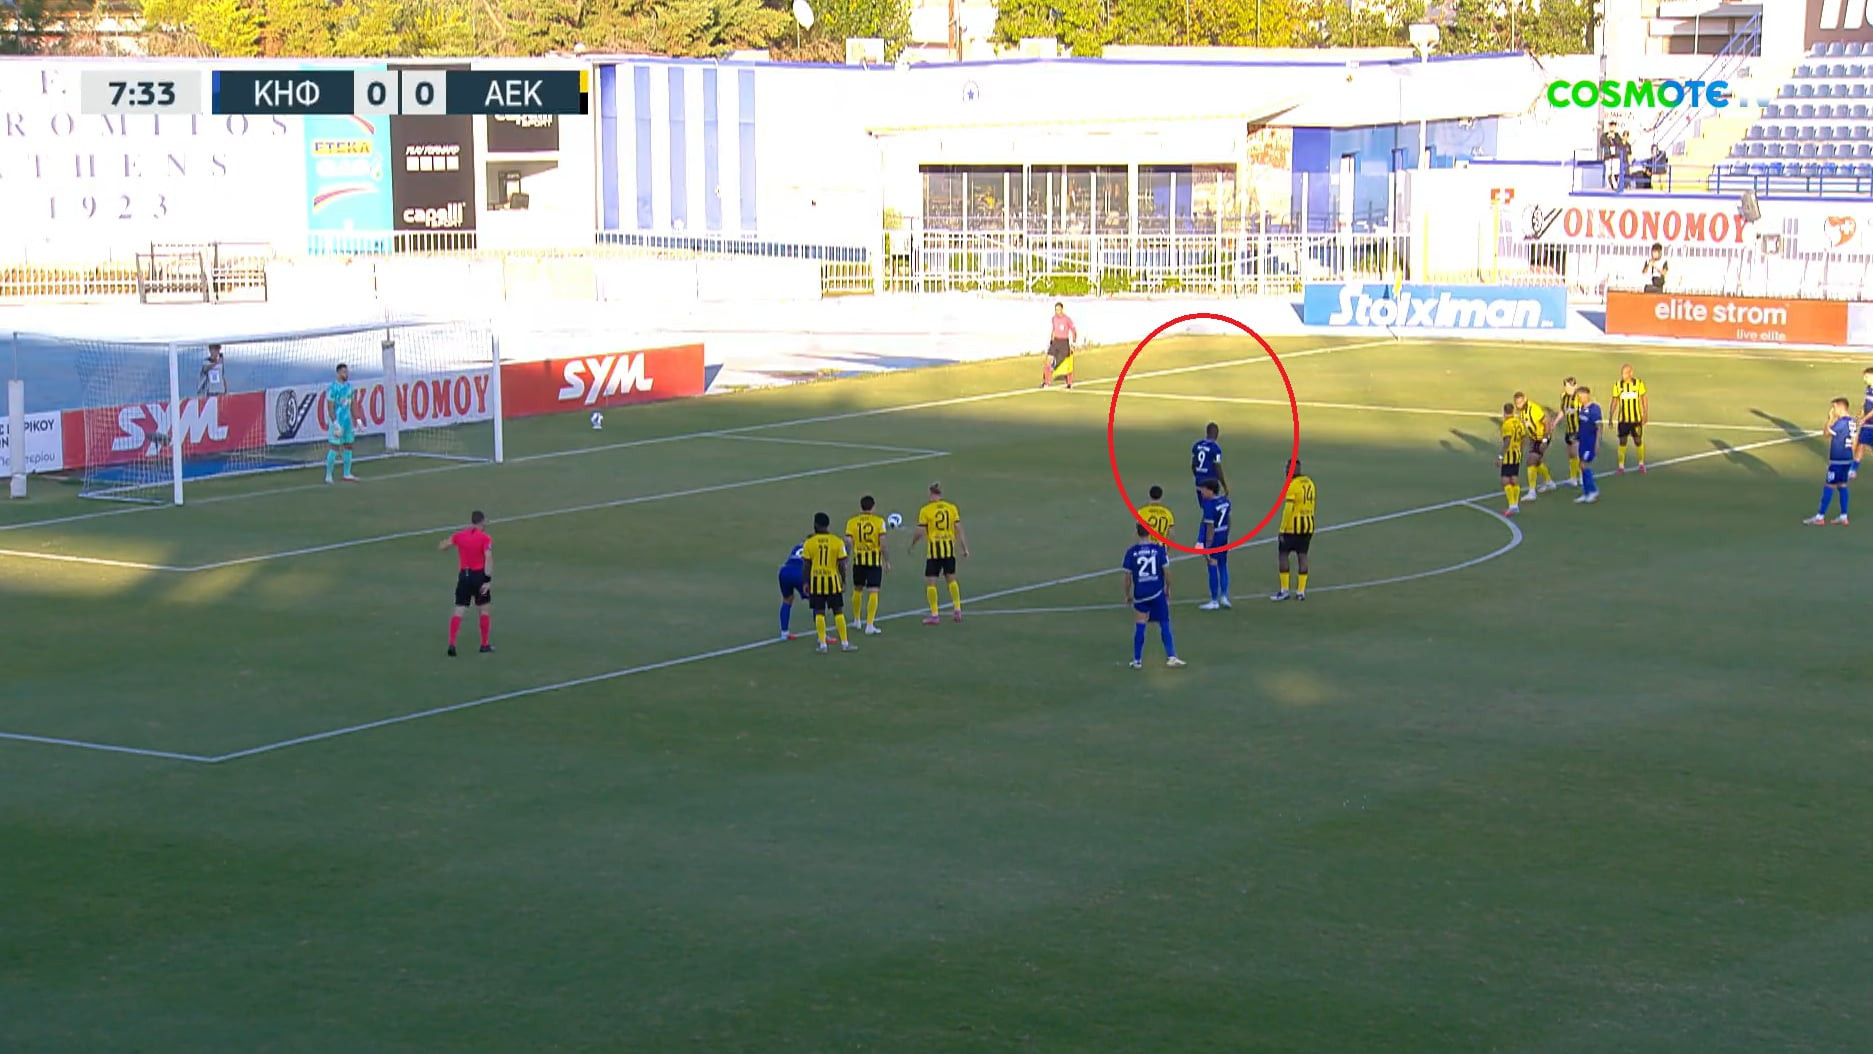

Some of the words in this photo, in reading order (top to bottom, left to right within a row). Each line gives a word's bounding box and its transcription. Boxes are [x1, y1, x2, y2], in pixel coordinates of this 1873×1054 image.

[50, 194, 167, 219] 1923
[1329, 284, 1542, 328] Stoiximan
[1655, 299, 1707, 321] elite
[1712, 302, 1787, 325] strom
[558, 352, 653, 405] SYM
[112, 396, 228, 456] SYM
[1197, 451, 1206, 468] 9
[1302, 485, 1314, 504] 14
[934, 510, 950, 531] 21
[1216, 508, 1227, 527] 7
[857, 522, 875, 543] 12
[818, 545, 829, 566] 11
[1137, 556, 1157, 577] 21
